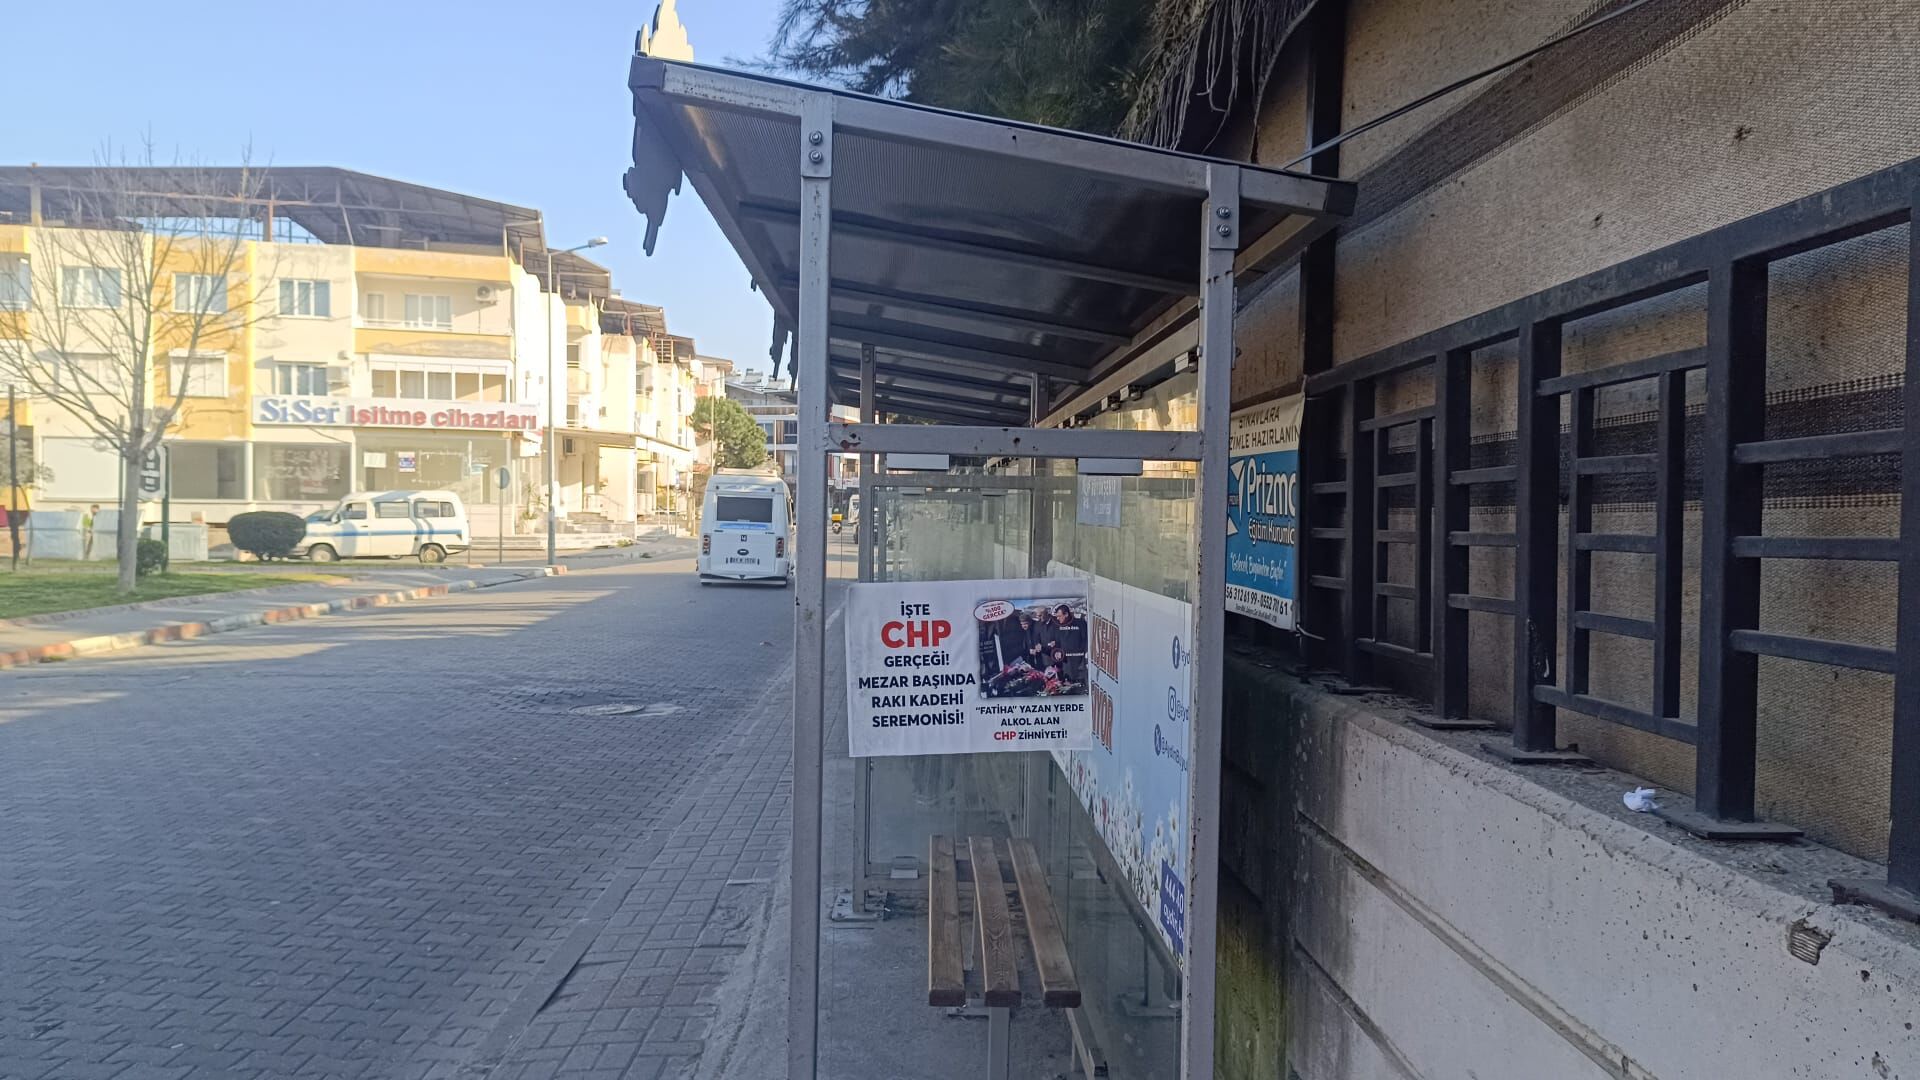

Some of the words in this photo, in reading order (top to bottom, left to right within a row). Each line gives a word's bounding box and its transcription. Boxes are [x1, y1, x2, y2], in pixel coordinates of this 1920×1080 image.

[431, 409, 537, 430] cihazları
[901, 601, 931, 618] İŞTE
[881, 619, 952, 648] CHP
[884, 651, 950, 669] GERÇEĞİ!
[859, 675, 909, 690] MEZAR
[912, 673, 976, 690] BAŞINDA
[872, 695, 906, 708] RAKI
[909, 689, 964, 707] KADEHİ
[976, 704, 1017, 715] "FATİHA"
[1019, 704, 1052, 714] YAZAN
[1054, 703, 1085, 713] YERDE
[872, 709, 964, 728] SEREMONİSİ!
[1001, 717, 1032, 727] ALKOL
[1034, 716, 1060, 726] ALAN
[994, 731, 1017, 741] CHP
[1018, 728, 1068, 741] ZİHNİYETİ!
